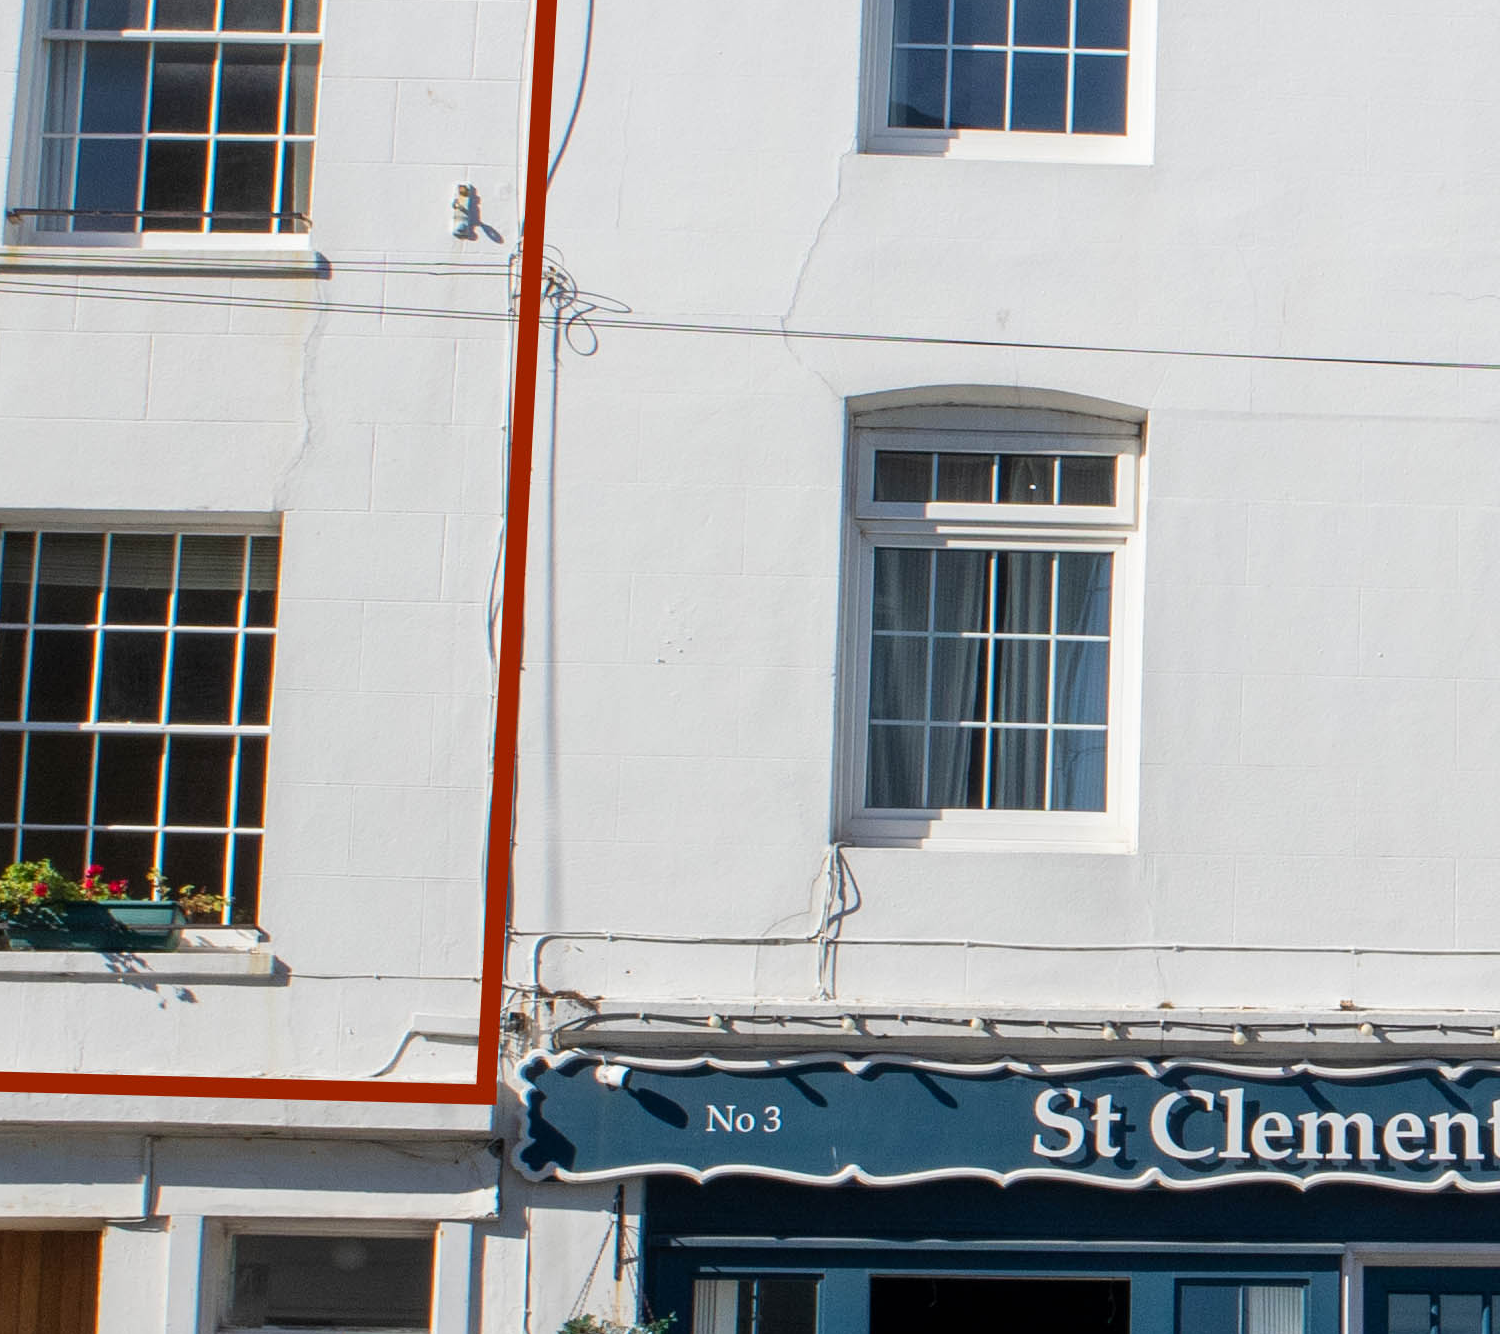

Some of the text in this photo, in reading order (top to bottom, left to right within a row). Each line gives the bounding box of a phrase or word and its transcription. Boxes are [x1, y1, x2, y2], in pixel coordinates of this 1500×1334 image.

[706, 1105, 782, 1134] No 3
[1032, 1087, 1121, 1159] St
